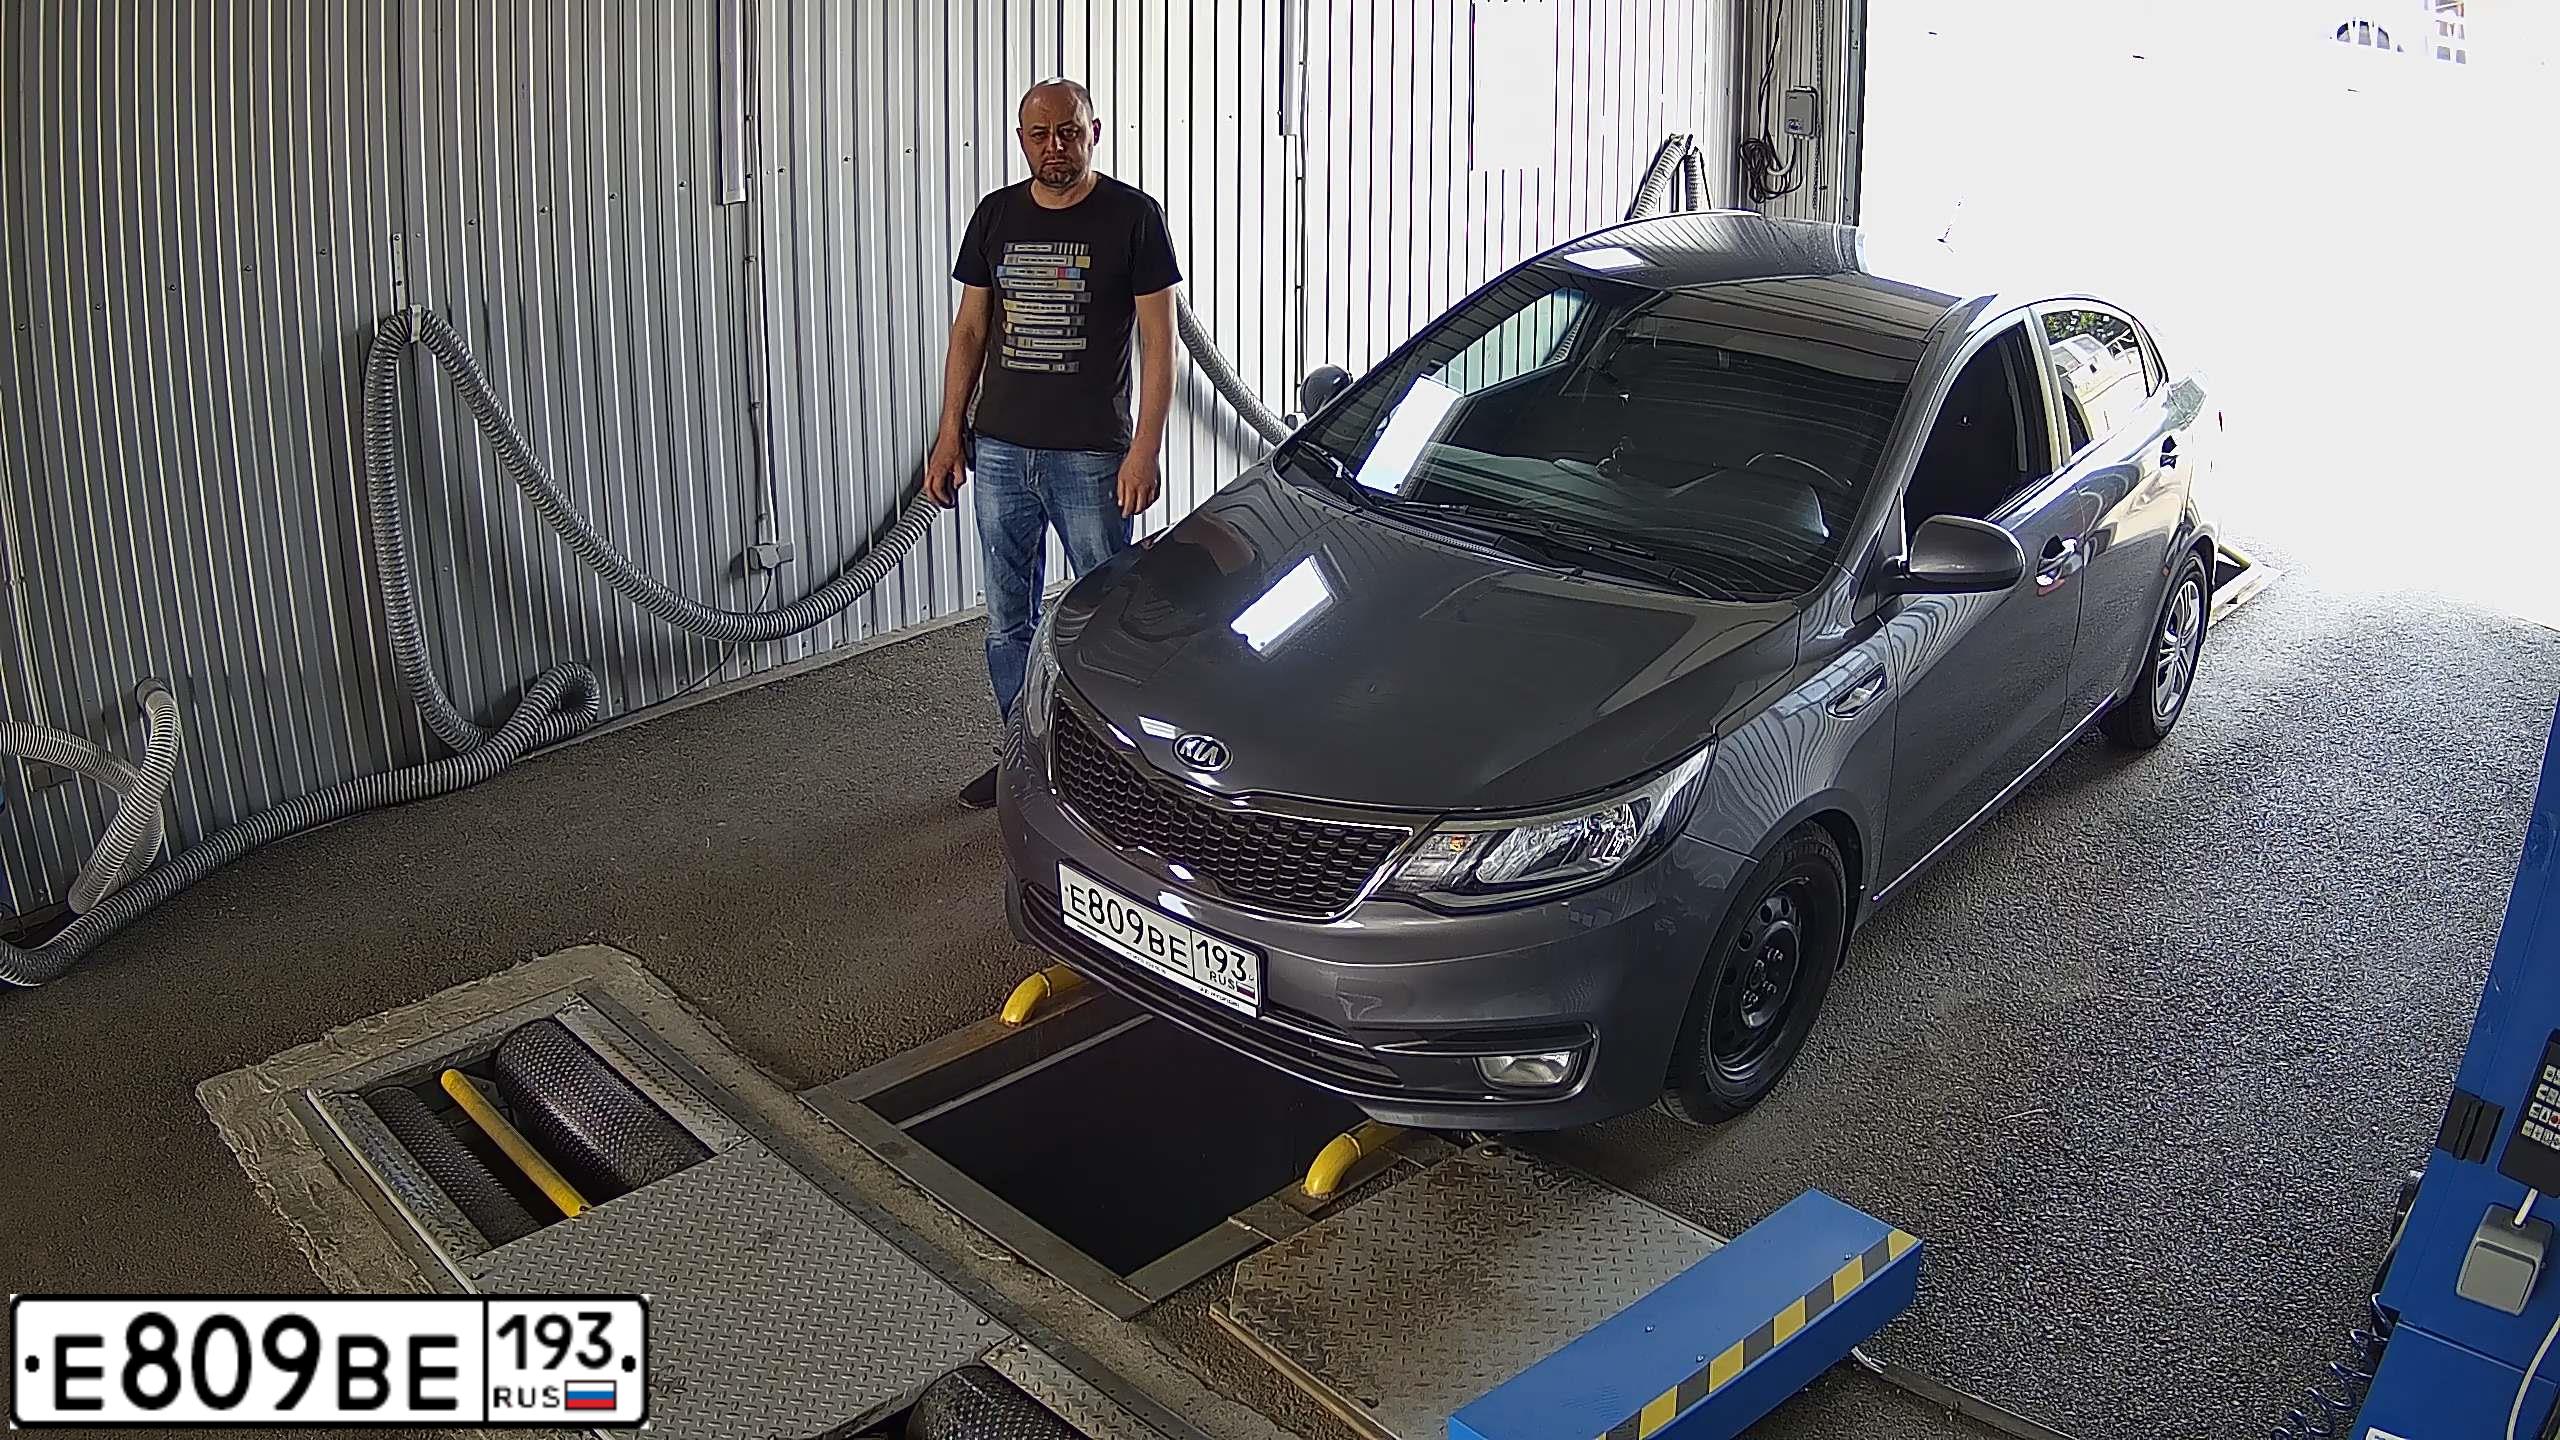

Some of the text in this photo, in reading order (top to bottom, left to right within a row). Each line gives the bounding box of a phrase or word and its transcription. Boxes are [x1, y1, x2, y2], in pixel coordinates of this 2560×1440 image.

[1070, 884, 1247, 982] E809BE 193
[1209, 971, 1236, 991] RUS
